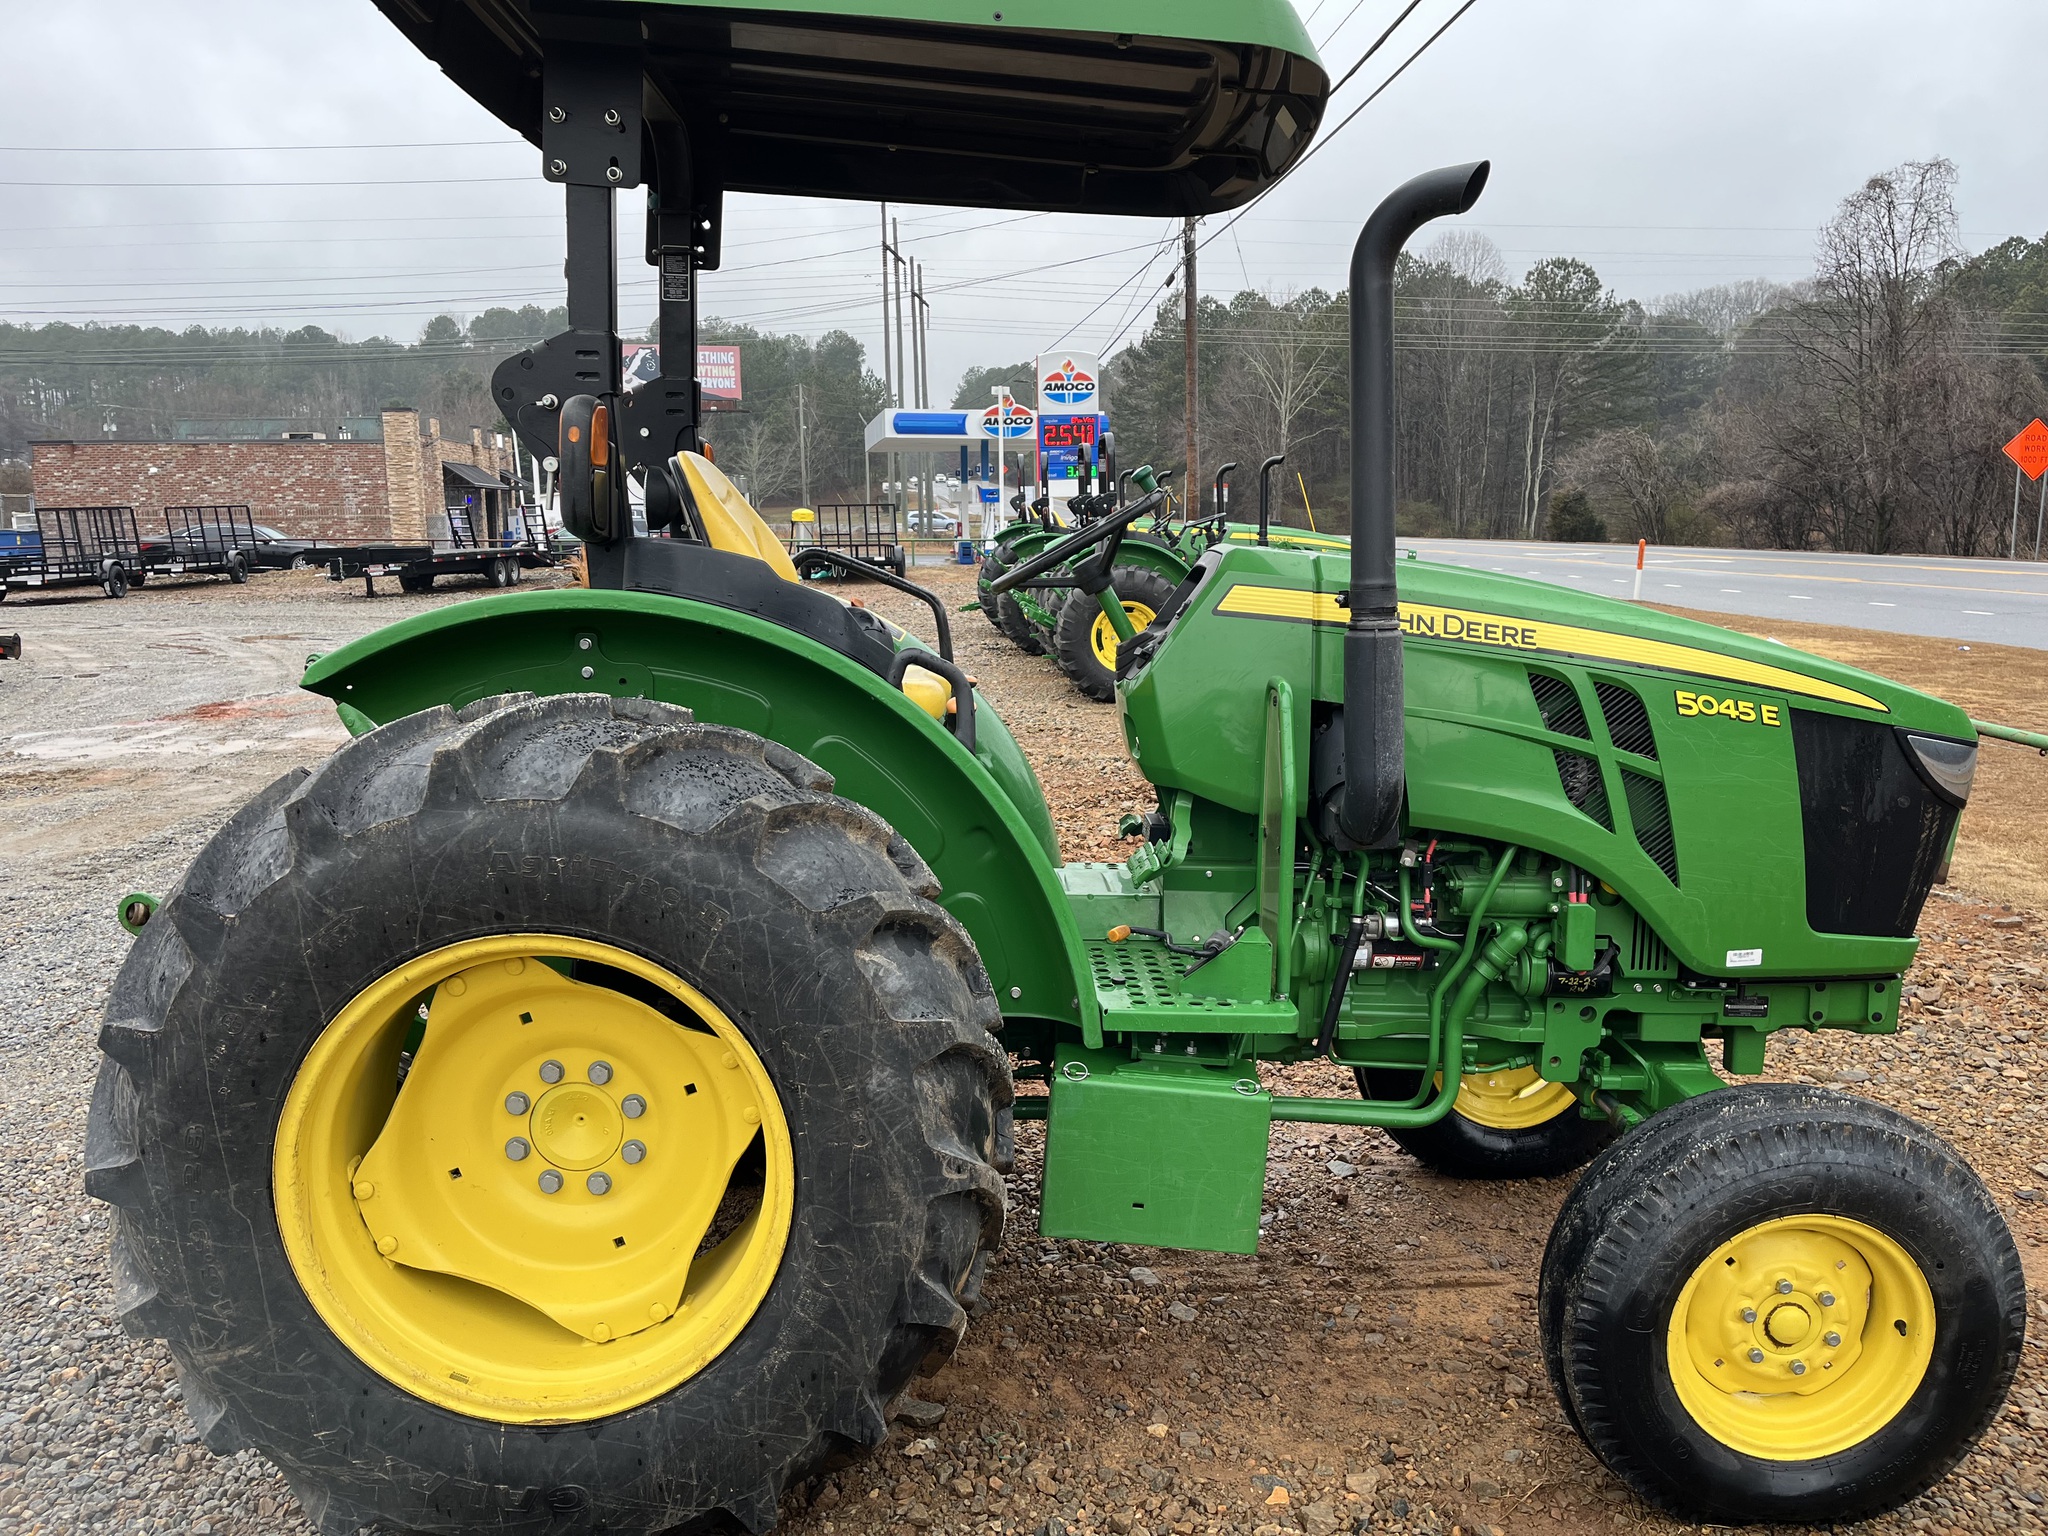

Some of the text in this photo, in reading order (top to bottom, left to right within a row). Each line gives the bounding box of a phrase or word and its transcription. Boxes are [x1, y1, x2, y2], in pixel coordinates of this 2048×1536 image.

[697, 352, 734, 364] ETHING
[1043, 383, 1095, 392] AMOCO
[1061, 454, 1078, 462] Invigo
[1397, 612, 1537, 646] HN DEERE
[1674, 690, 1781, 728] 5045 E
